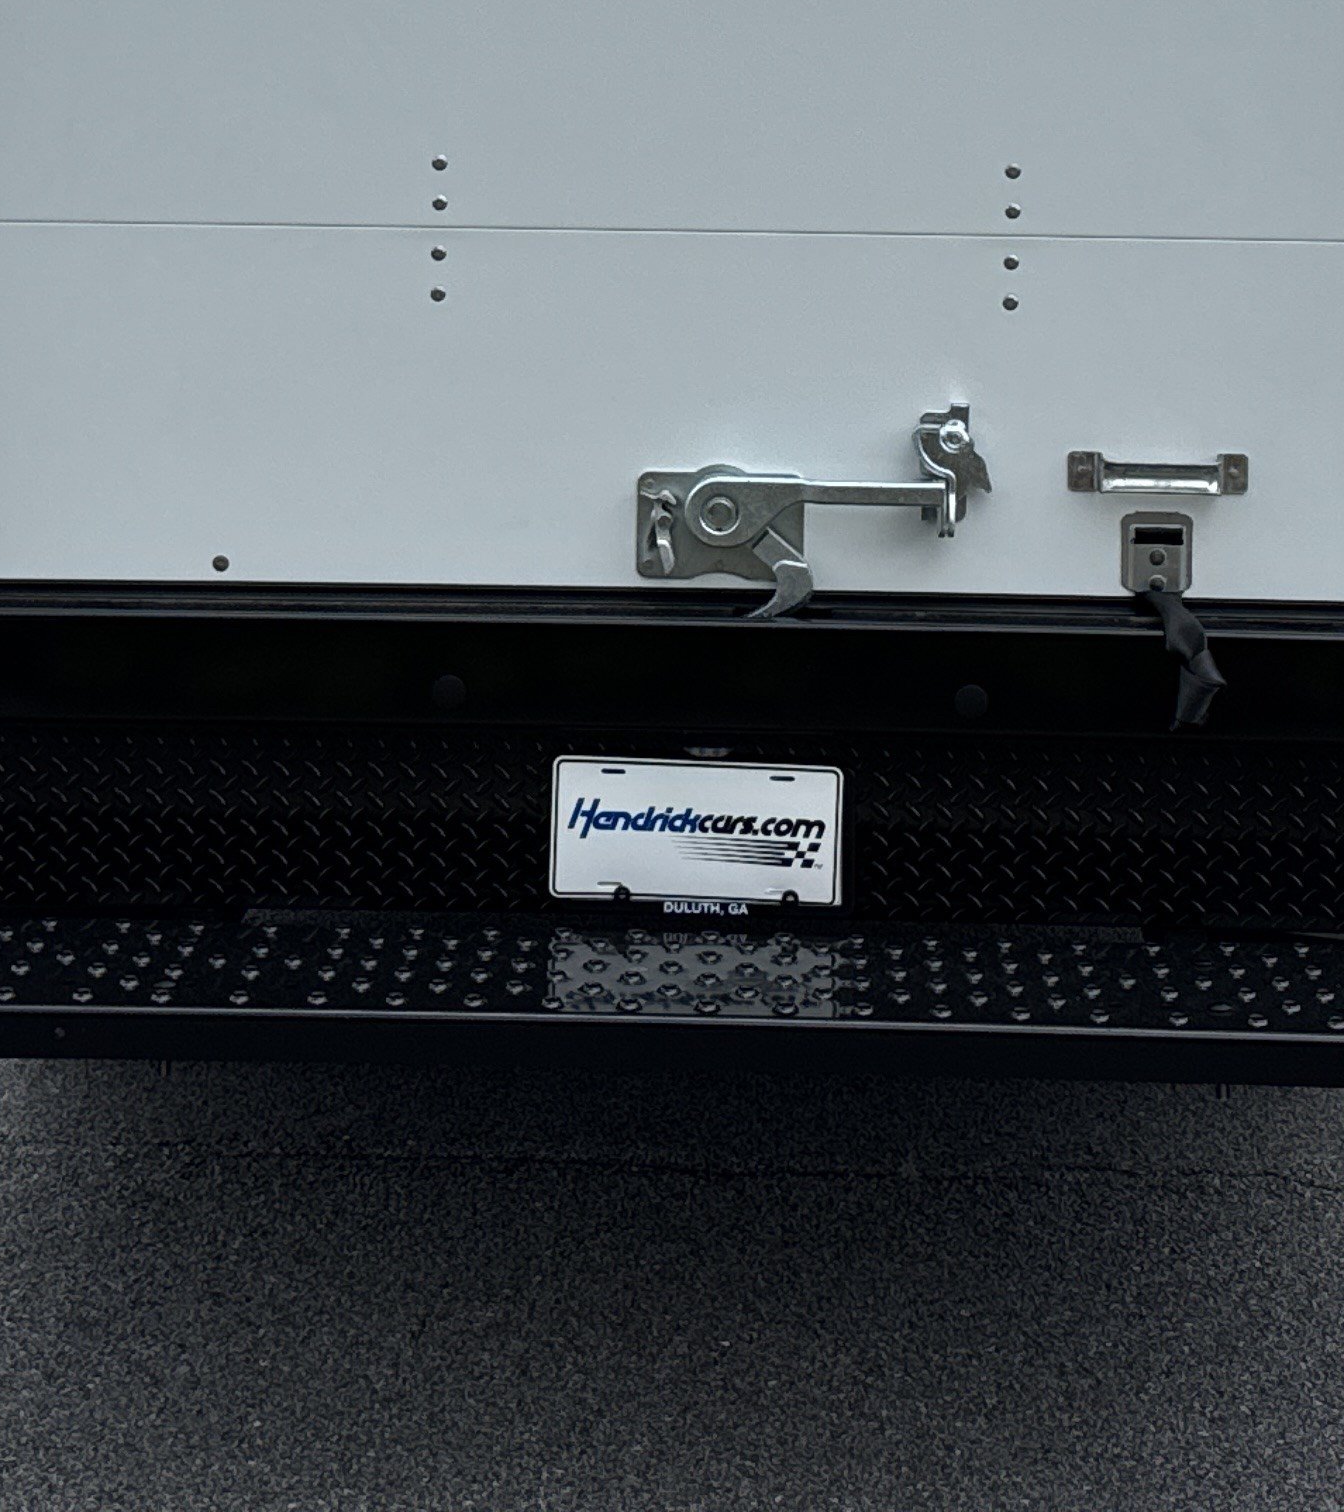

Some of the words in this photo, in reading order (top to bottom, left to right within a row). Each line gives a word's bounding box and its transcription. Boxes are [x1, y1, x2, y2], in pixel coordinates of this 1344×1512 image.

[567, 797, 826, 839] Hendrickcars.com
[663, 901, 724, 916] DULUTH,
[728, 902, 749, 916] GA
